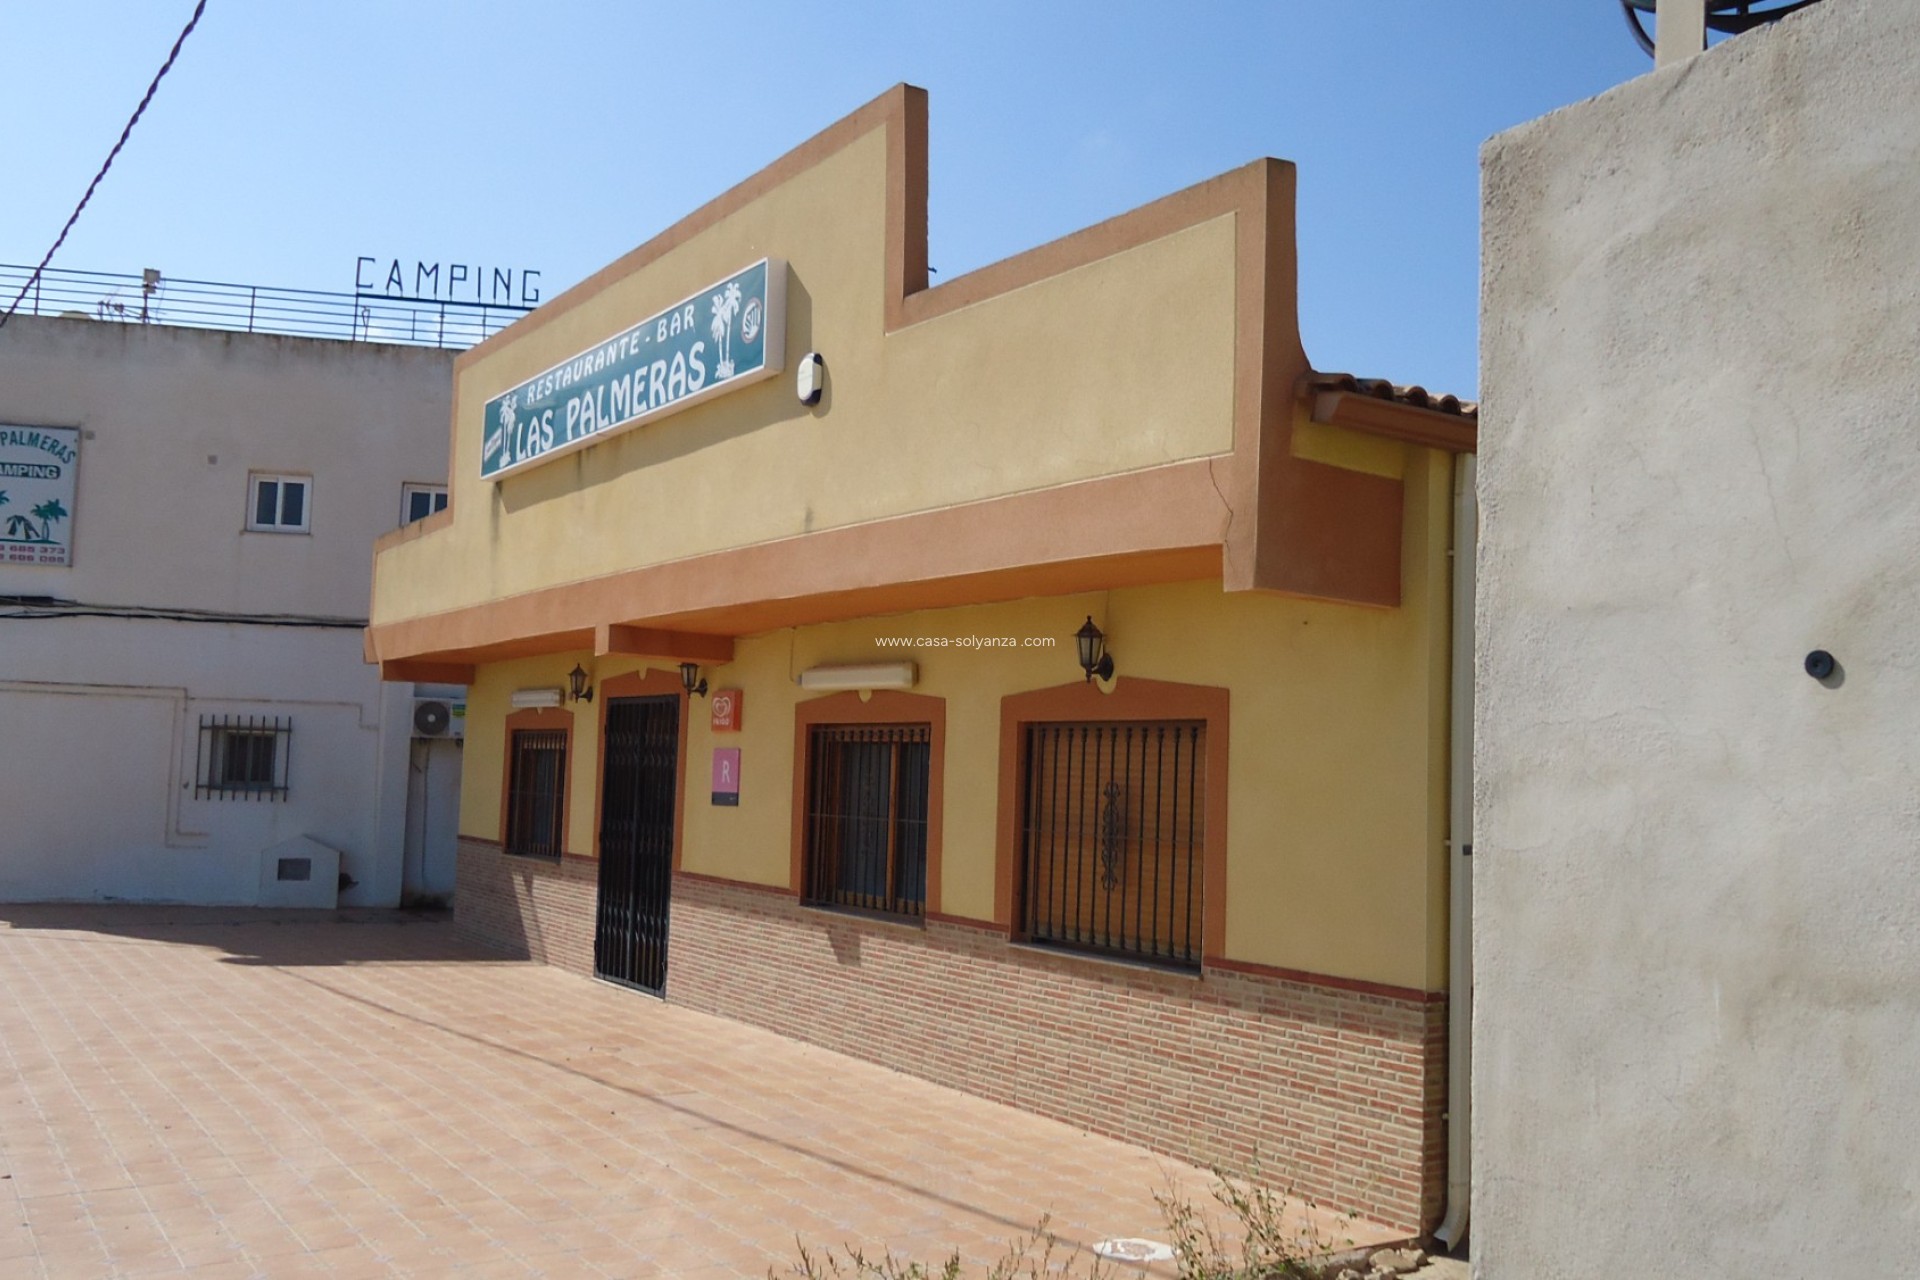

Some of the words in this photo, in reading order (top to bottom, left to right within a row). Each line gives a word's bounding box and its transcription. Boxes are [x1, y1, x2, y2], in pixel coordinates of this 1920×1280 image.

[355, 256, 541, 303] CAMPING
[526, 331, 640, 405] RESTAURANTE
[656, 304, 696, 343] BAR
[516, 409, 554, 462] LAS
[566, 341, 706, 441] PALMERAS
[0, 430, 76, 464] PALMERAS
[721, 760, 730, 784] R
